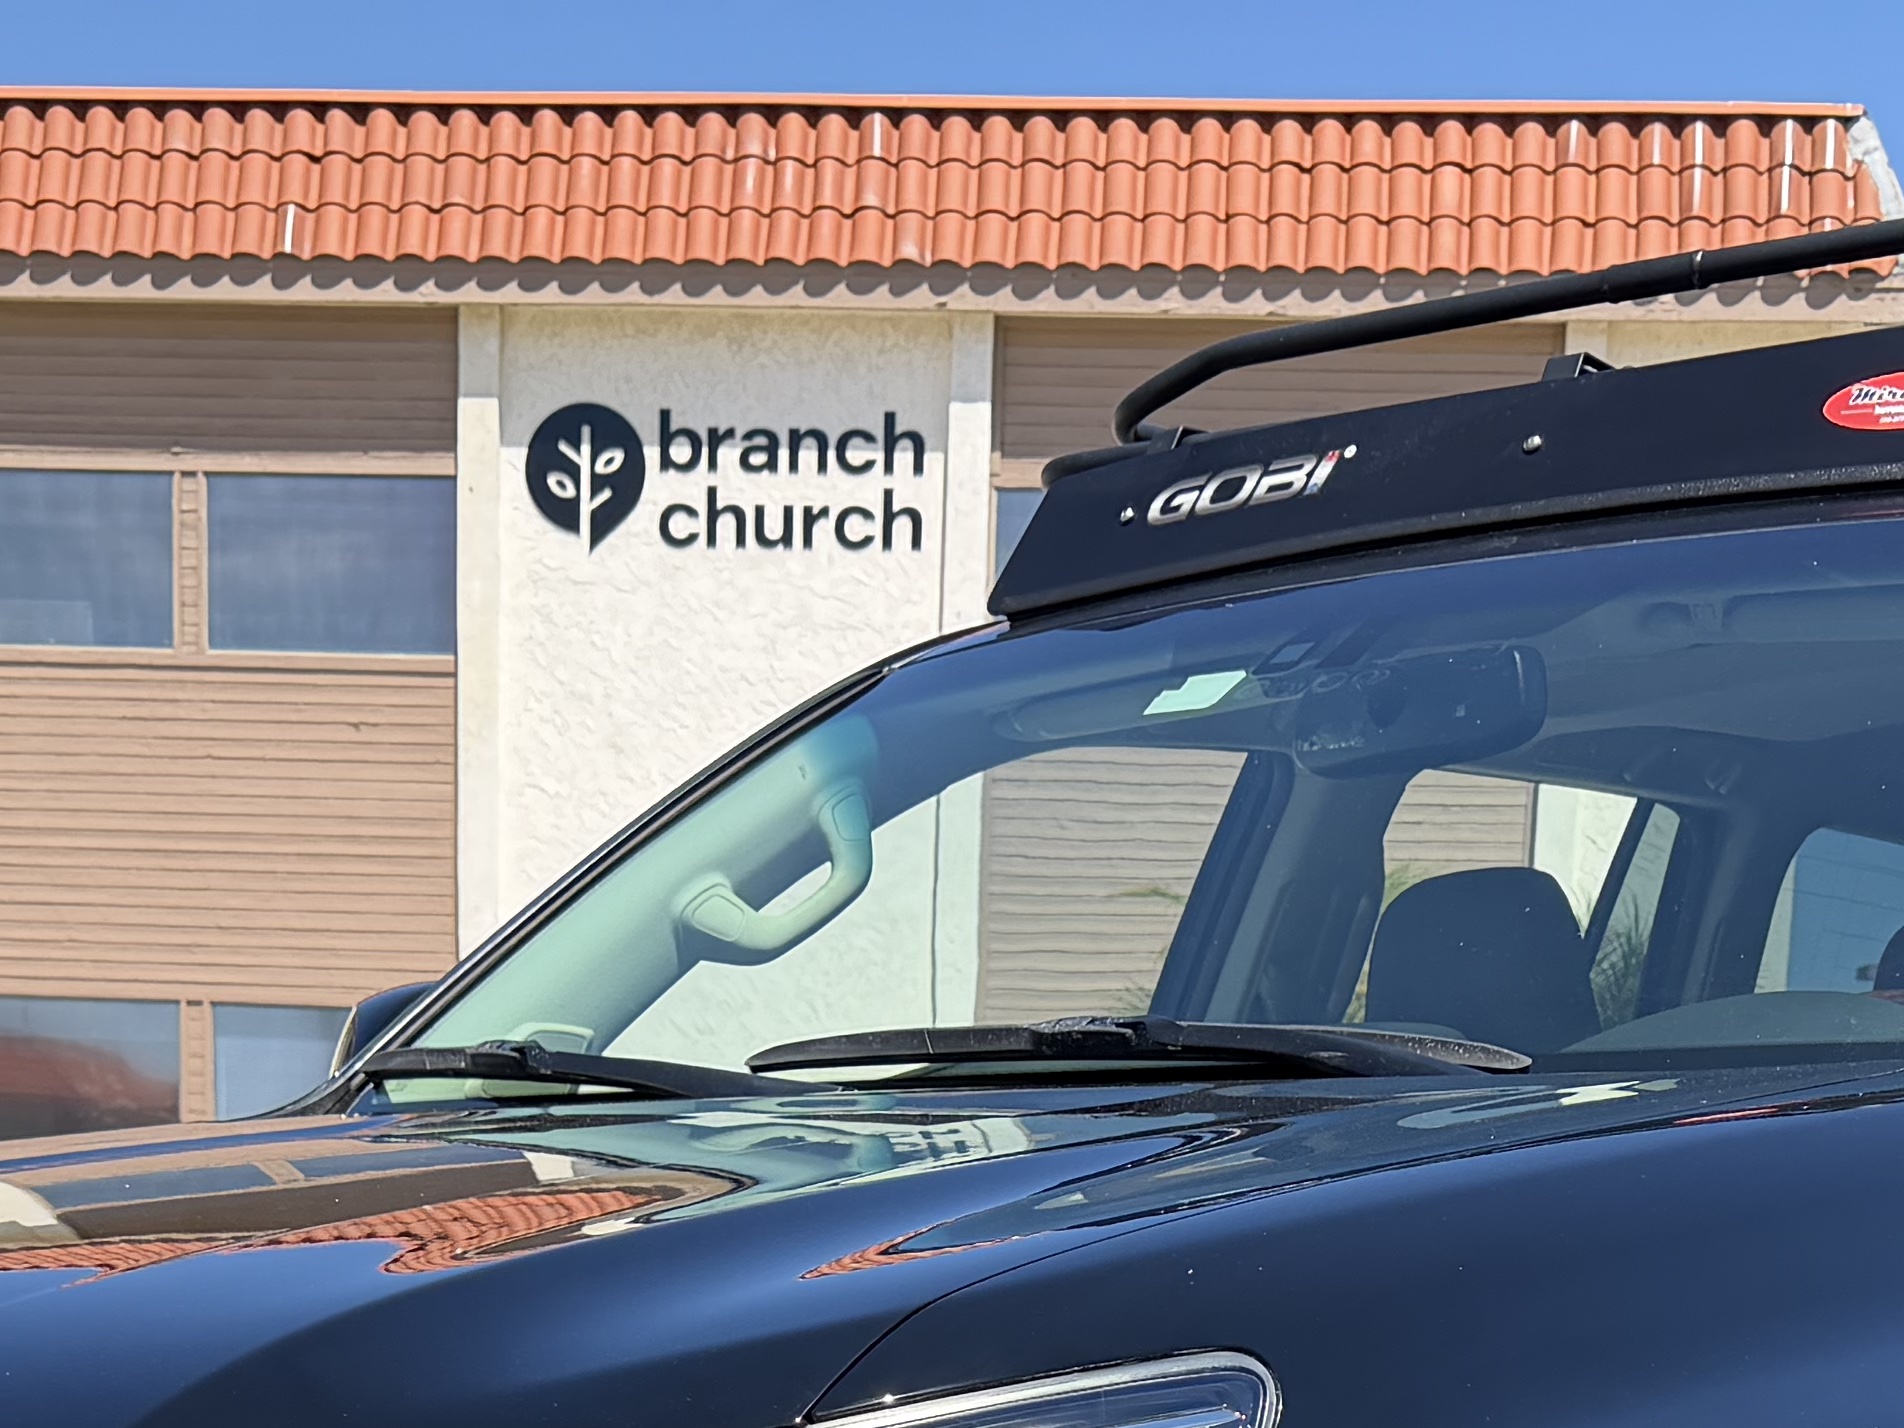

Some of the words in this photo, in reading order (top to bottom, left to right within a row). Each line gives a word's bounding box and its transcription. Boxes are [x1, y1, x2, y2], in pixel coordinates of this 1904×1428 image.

[659, 408, 926, 477] branch
[658, 485, 924, 552] church
[1147, 449, 1342, 526] GOBI
